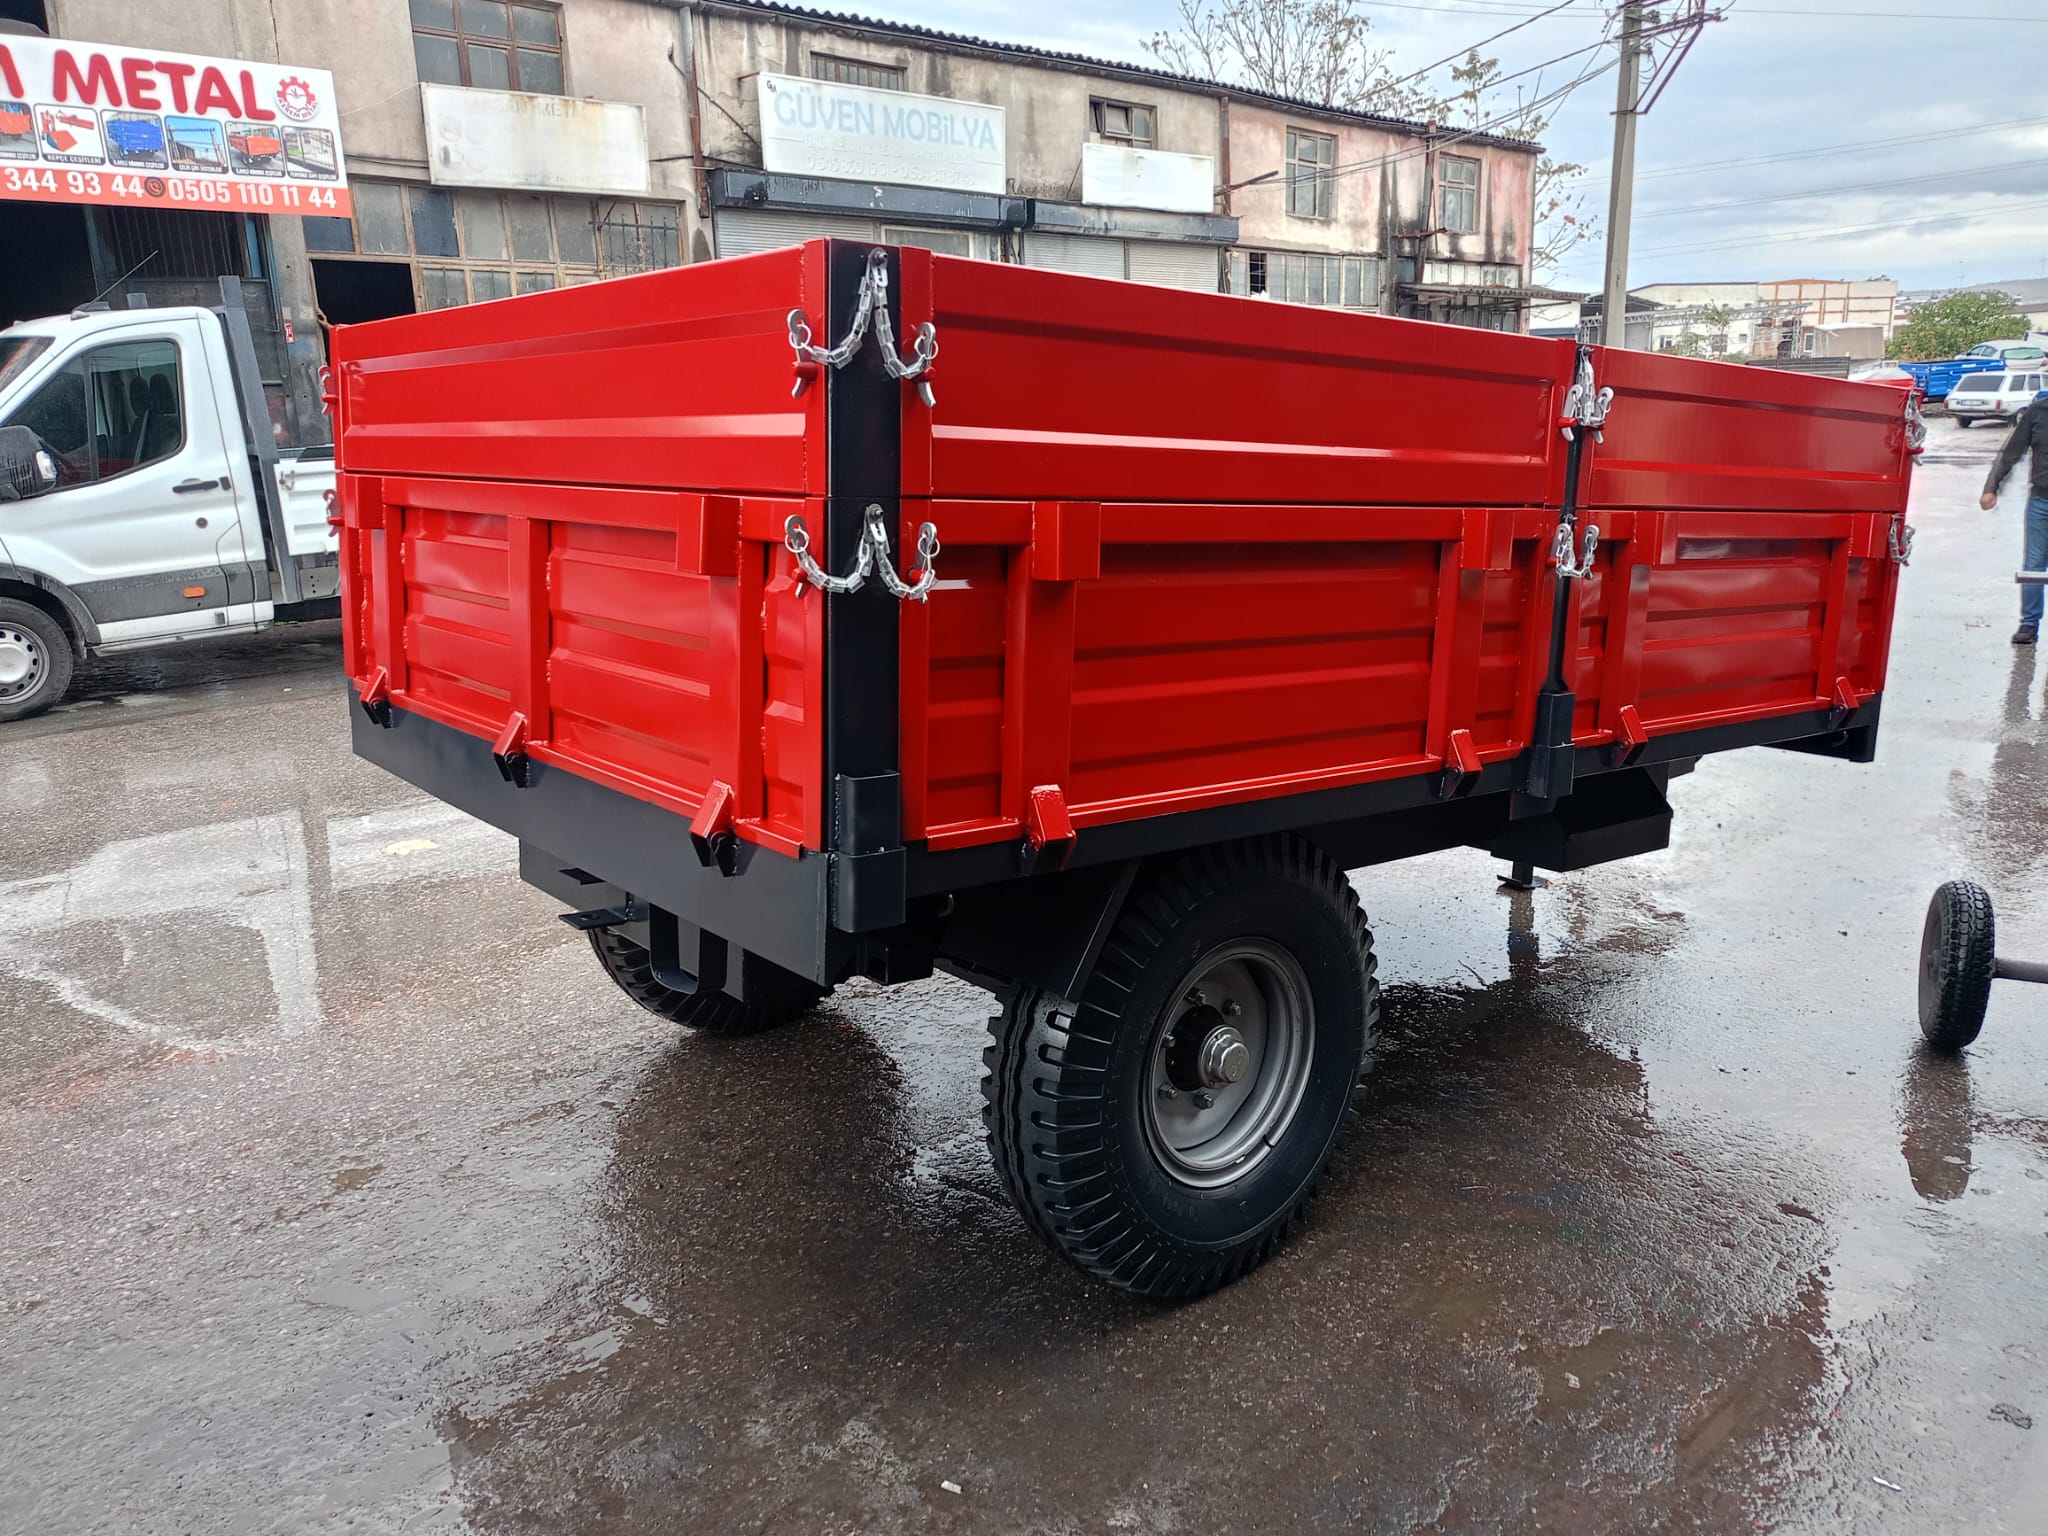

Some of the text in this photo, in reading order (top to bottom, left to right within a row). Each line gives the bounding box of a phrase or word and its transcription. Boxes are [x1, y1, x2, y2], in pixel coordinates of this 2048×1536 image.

[53, 49, 276, 121] METAL
[774, 86, 875, 135] GÜVEN
[4, 167, 145, 198] 344 93 44
[168, 178, 337, 209] 0505 110 11 44
